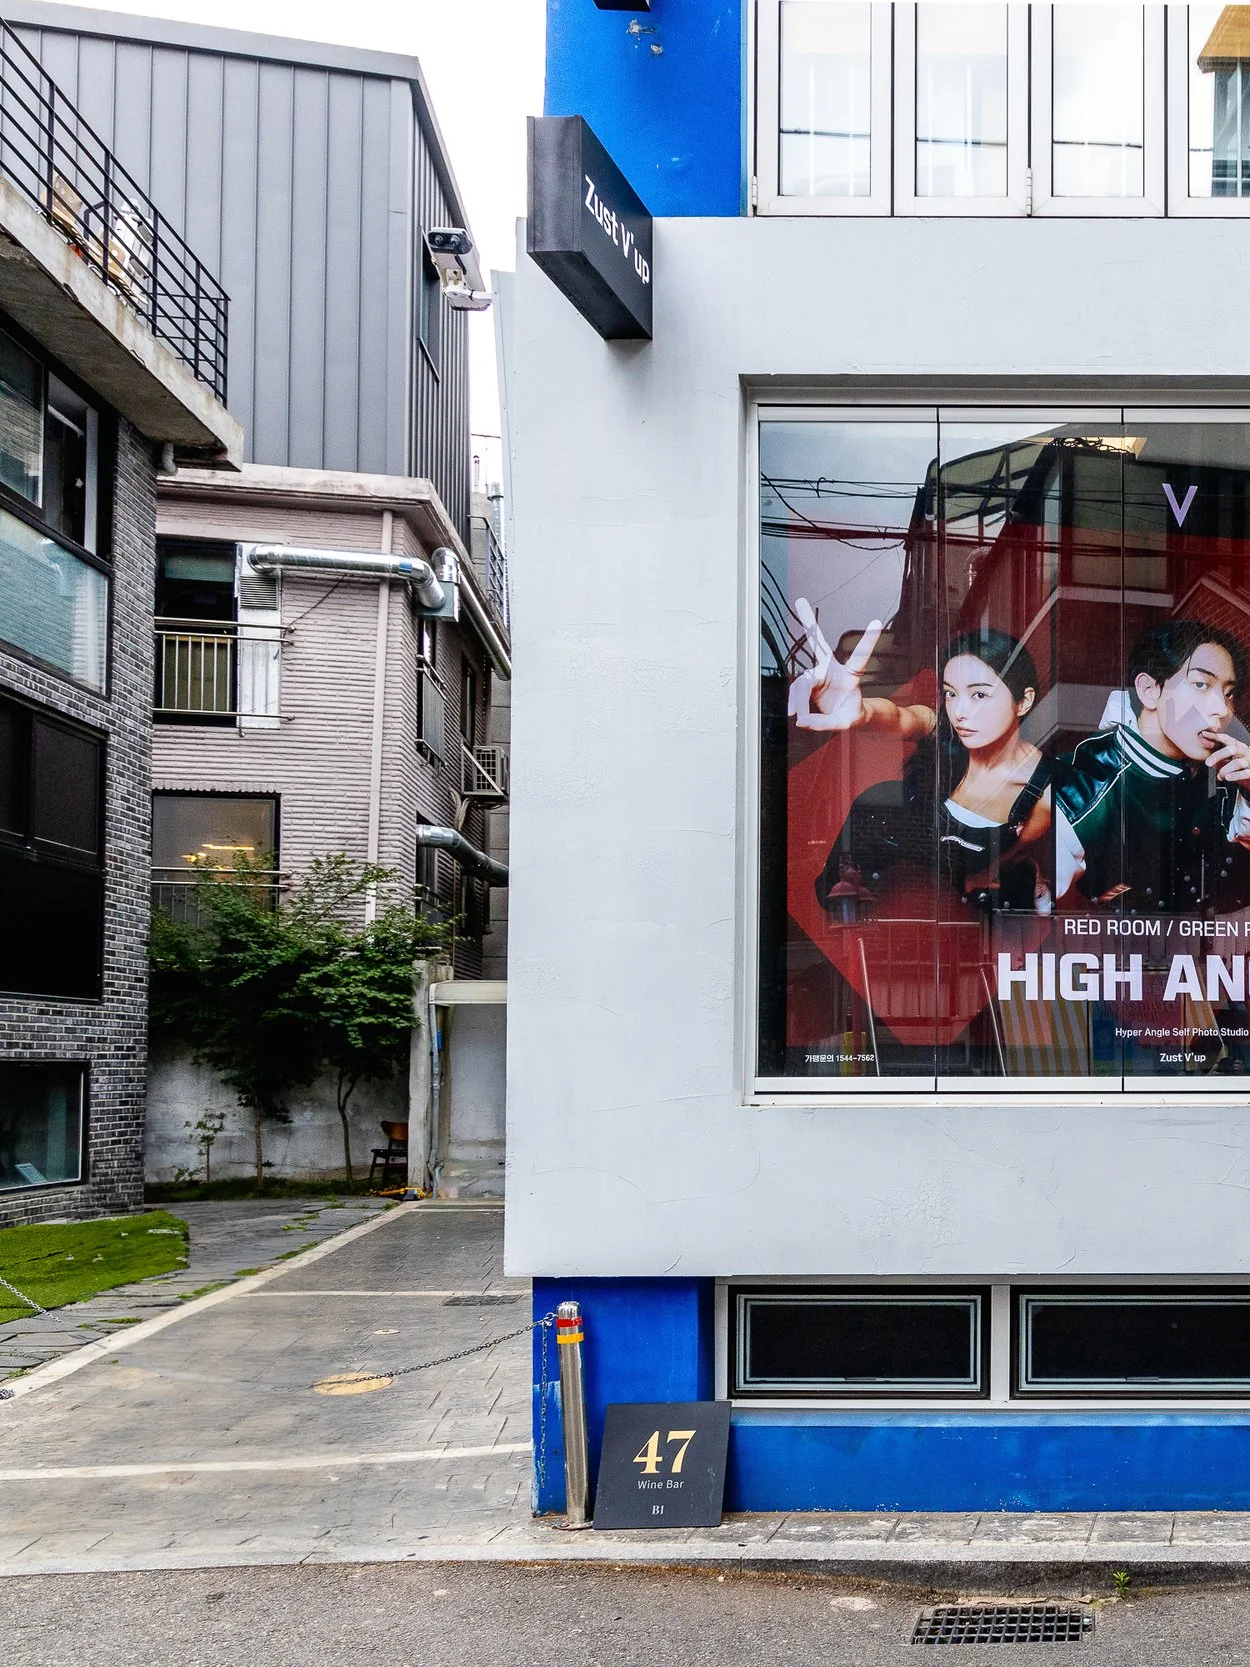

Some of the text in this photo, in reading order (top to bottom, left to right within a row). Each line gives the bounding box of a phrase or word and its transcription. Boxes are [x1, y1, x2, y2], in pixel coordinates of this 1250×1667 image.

[584, 174, 650, 285] Zust V'up
[1161, 483, 1198, 528] V
[1064, 919, 1101, 936] RED
[1106, 920, 1161, 937] ROOM
[1166, 920, 1172, 937] /
[1179, 921, 1239, 937] GREEN
[998, 952, 1143, 1001] HIGH
[1115, 1027, 1249, 1039] Hyper Angle Self Photo Studio
[836, 1054, 874, 1062] 1544-7562
[1159, 1052, 1206, 1063] Zust V'up
[632, 1429, 697, 1474] 47
[637, 1480, 684, 1489] Wine Bar
[651, 1505, 665, 1515] B1
